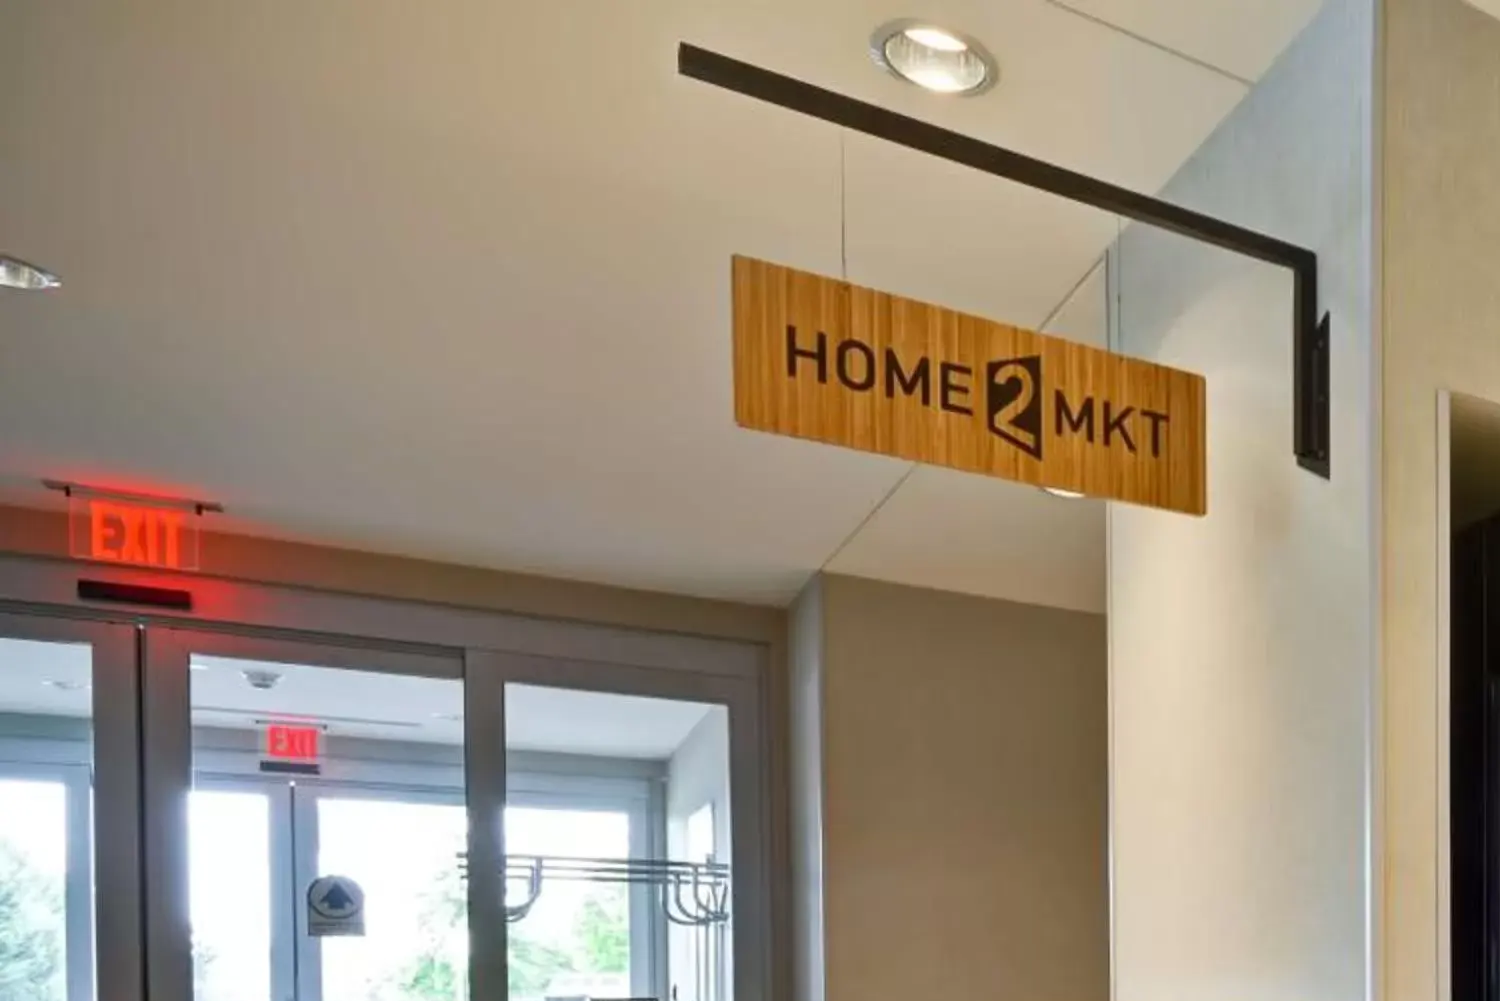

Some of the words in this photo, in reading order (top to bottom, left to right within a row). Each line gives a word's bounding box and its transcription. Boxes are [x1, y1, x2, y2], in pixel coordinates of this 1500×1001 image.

[1055, 389, 1169, 459] MKT
[90, 500, 187, 568] EXIT
[267, 723, 319, 760] EXIT
